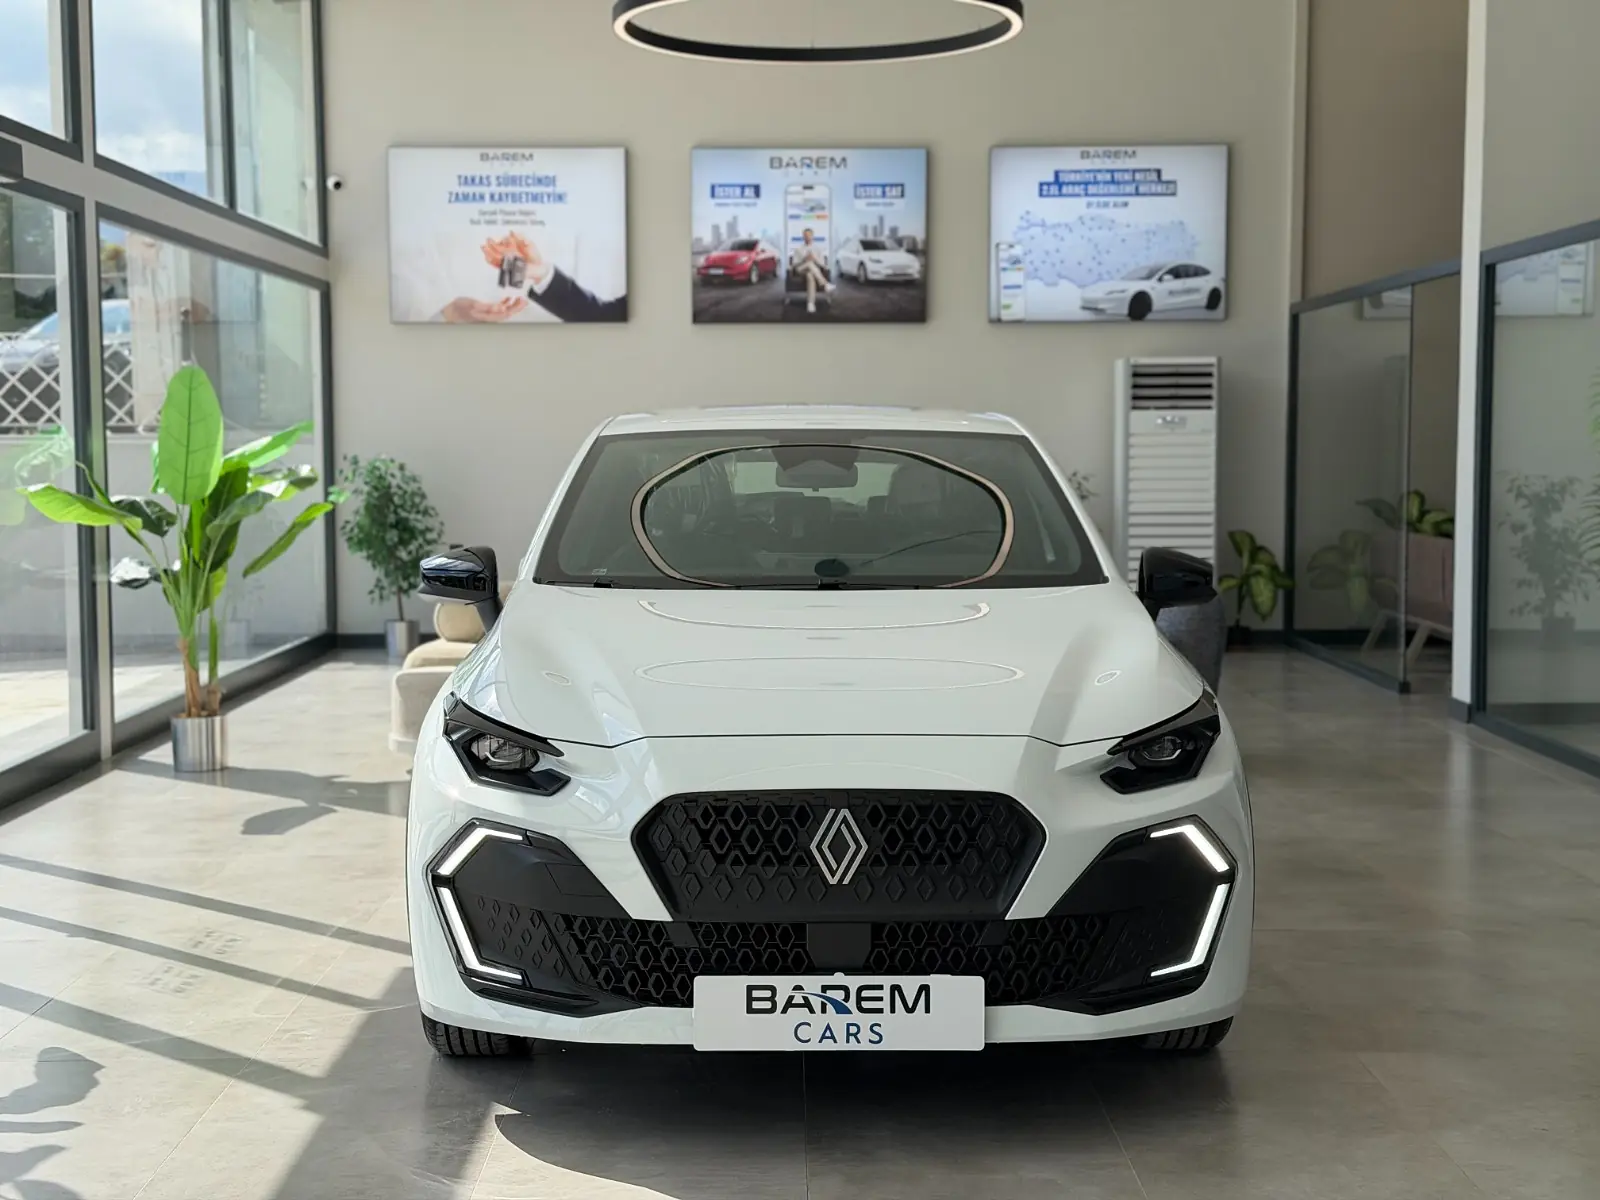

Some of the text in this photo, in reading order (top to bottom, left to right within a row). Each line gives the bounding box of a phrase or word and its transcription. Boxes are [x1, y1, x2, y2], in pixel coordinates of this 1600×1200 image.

[769, 156, 848, 169] BAREM
[457, 174, 492, 187] TAKAS
[447, 191, 486, 204] ZAMAN
[745, 983, 931, 1015] BAREM
[793, 1021, 884, 1045] CARS
